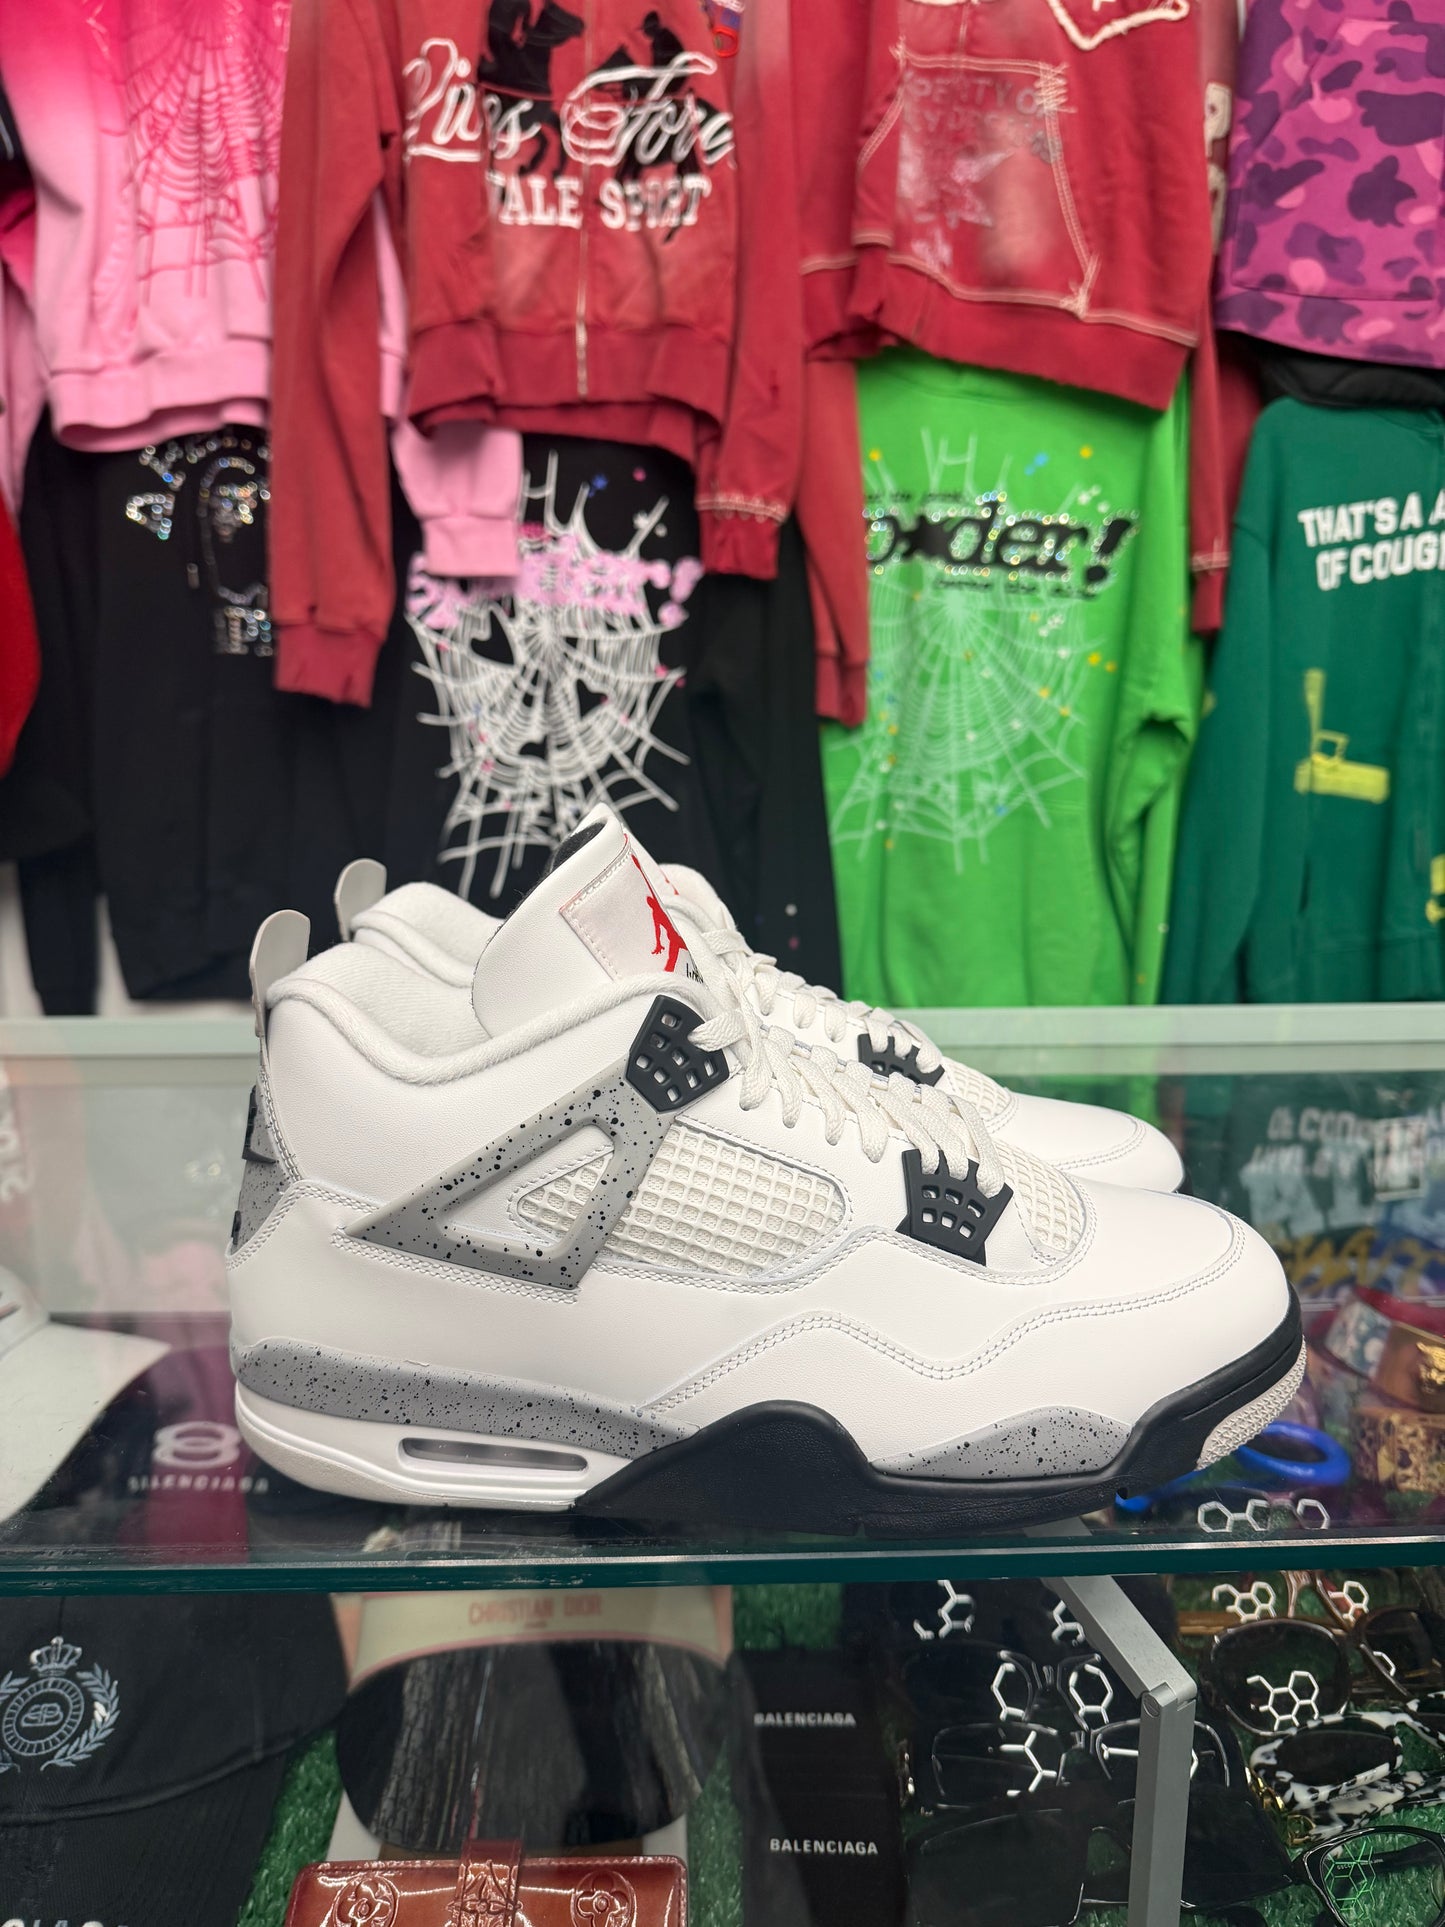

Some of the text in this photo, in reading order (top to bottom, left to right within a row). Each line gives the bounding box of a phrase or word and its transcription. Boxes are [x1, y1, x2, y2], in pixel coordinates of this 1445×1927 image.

[1297, 497, 1398, 548] THAT'S
[1399, 491, 1423, 531] A
[1315, 547, 1348, 592] OF
[753, 1711, 858, 1728] BALENCIAGA
[769, 1837, 879, 1856] BALENCIAGA
